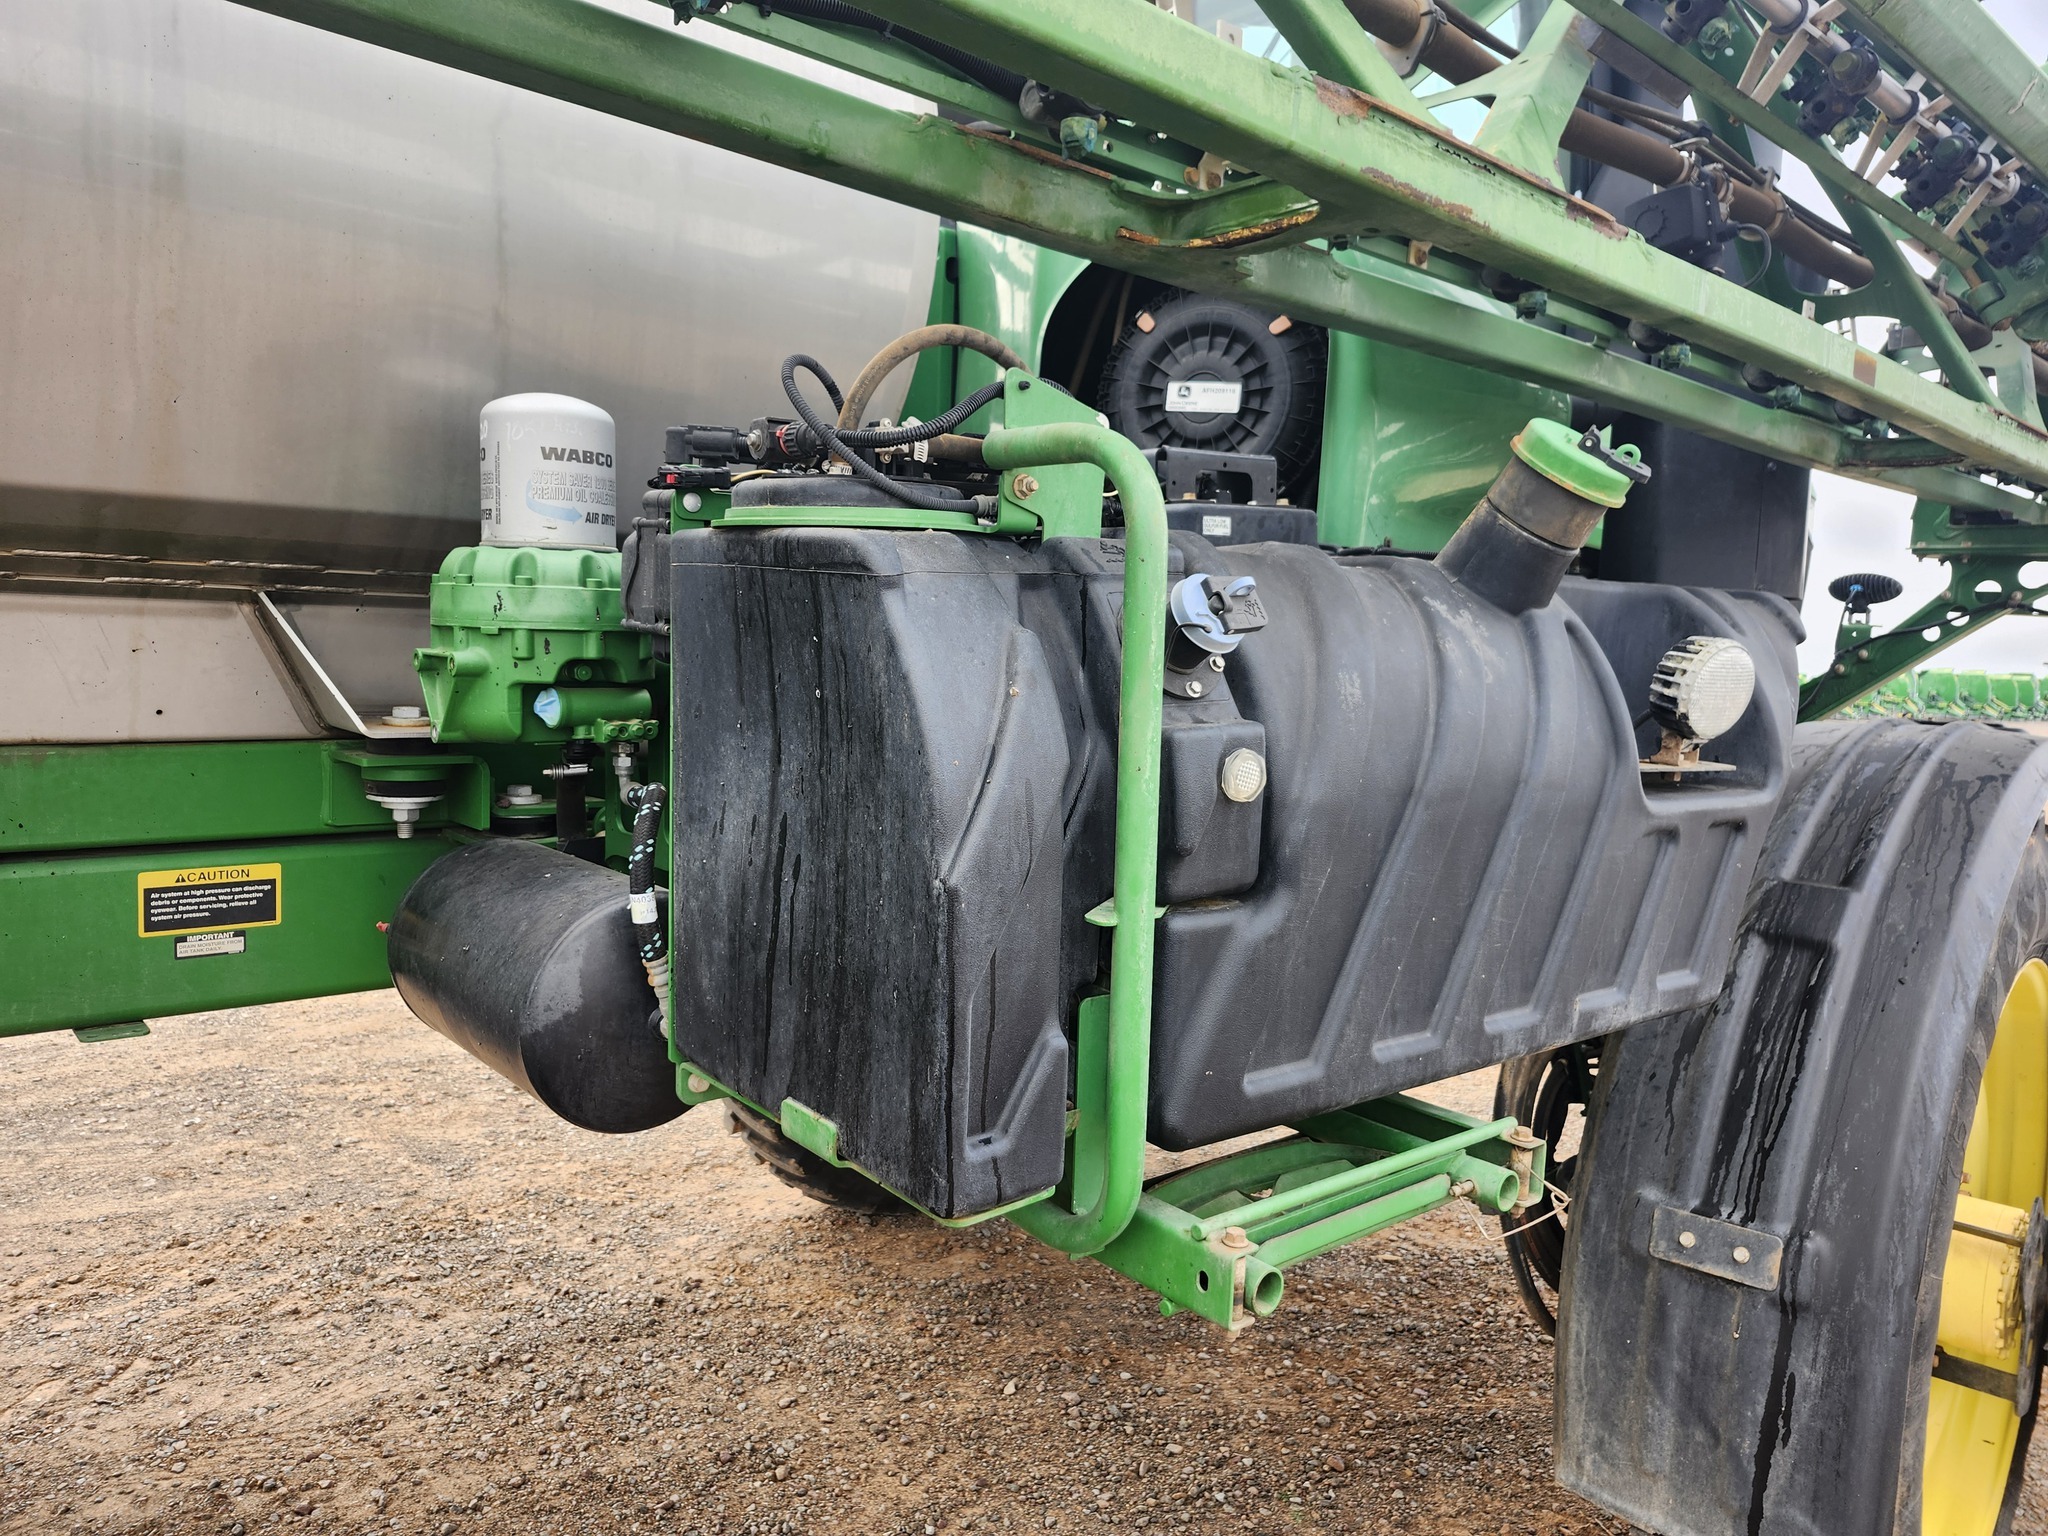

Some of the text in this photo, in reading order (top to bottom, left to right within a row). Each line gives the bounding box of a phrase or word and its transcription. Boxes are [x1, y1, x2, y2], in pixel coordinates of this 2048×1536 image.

[540, 446, 613, 468] WABCO
[532, 470, 567, 486] SYSTEM
[569, 472, 593, 489] SAVER
[532, 485, 573, 501] PREMIUM
[575, 488, 588, 503] OIL
[585, 511, 616, 527] AIR DRYE
[187, 869, 250, 882] CAUTION
[191, 889, 204, 897] high
[205, 886, 230, 895] pressure
[243, 884, 271, 892] discharge
[179, 896, 218, 904] components.
[234, 892, 263, 900] protective
[199, 902, 228, 910] servicing,
[150, 914, 172, 922] system
[183, 911, 211, 919] pressure.
[187, 932, 235, 942] IMPORTANT
